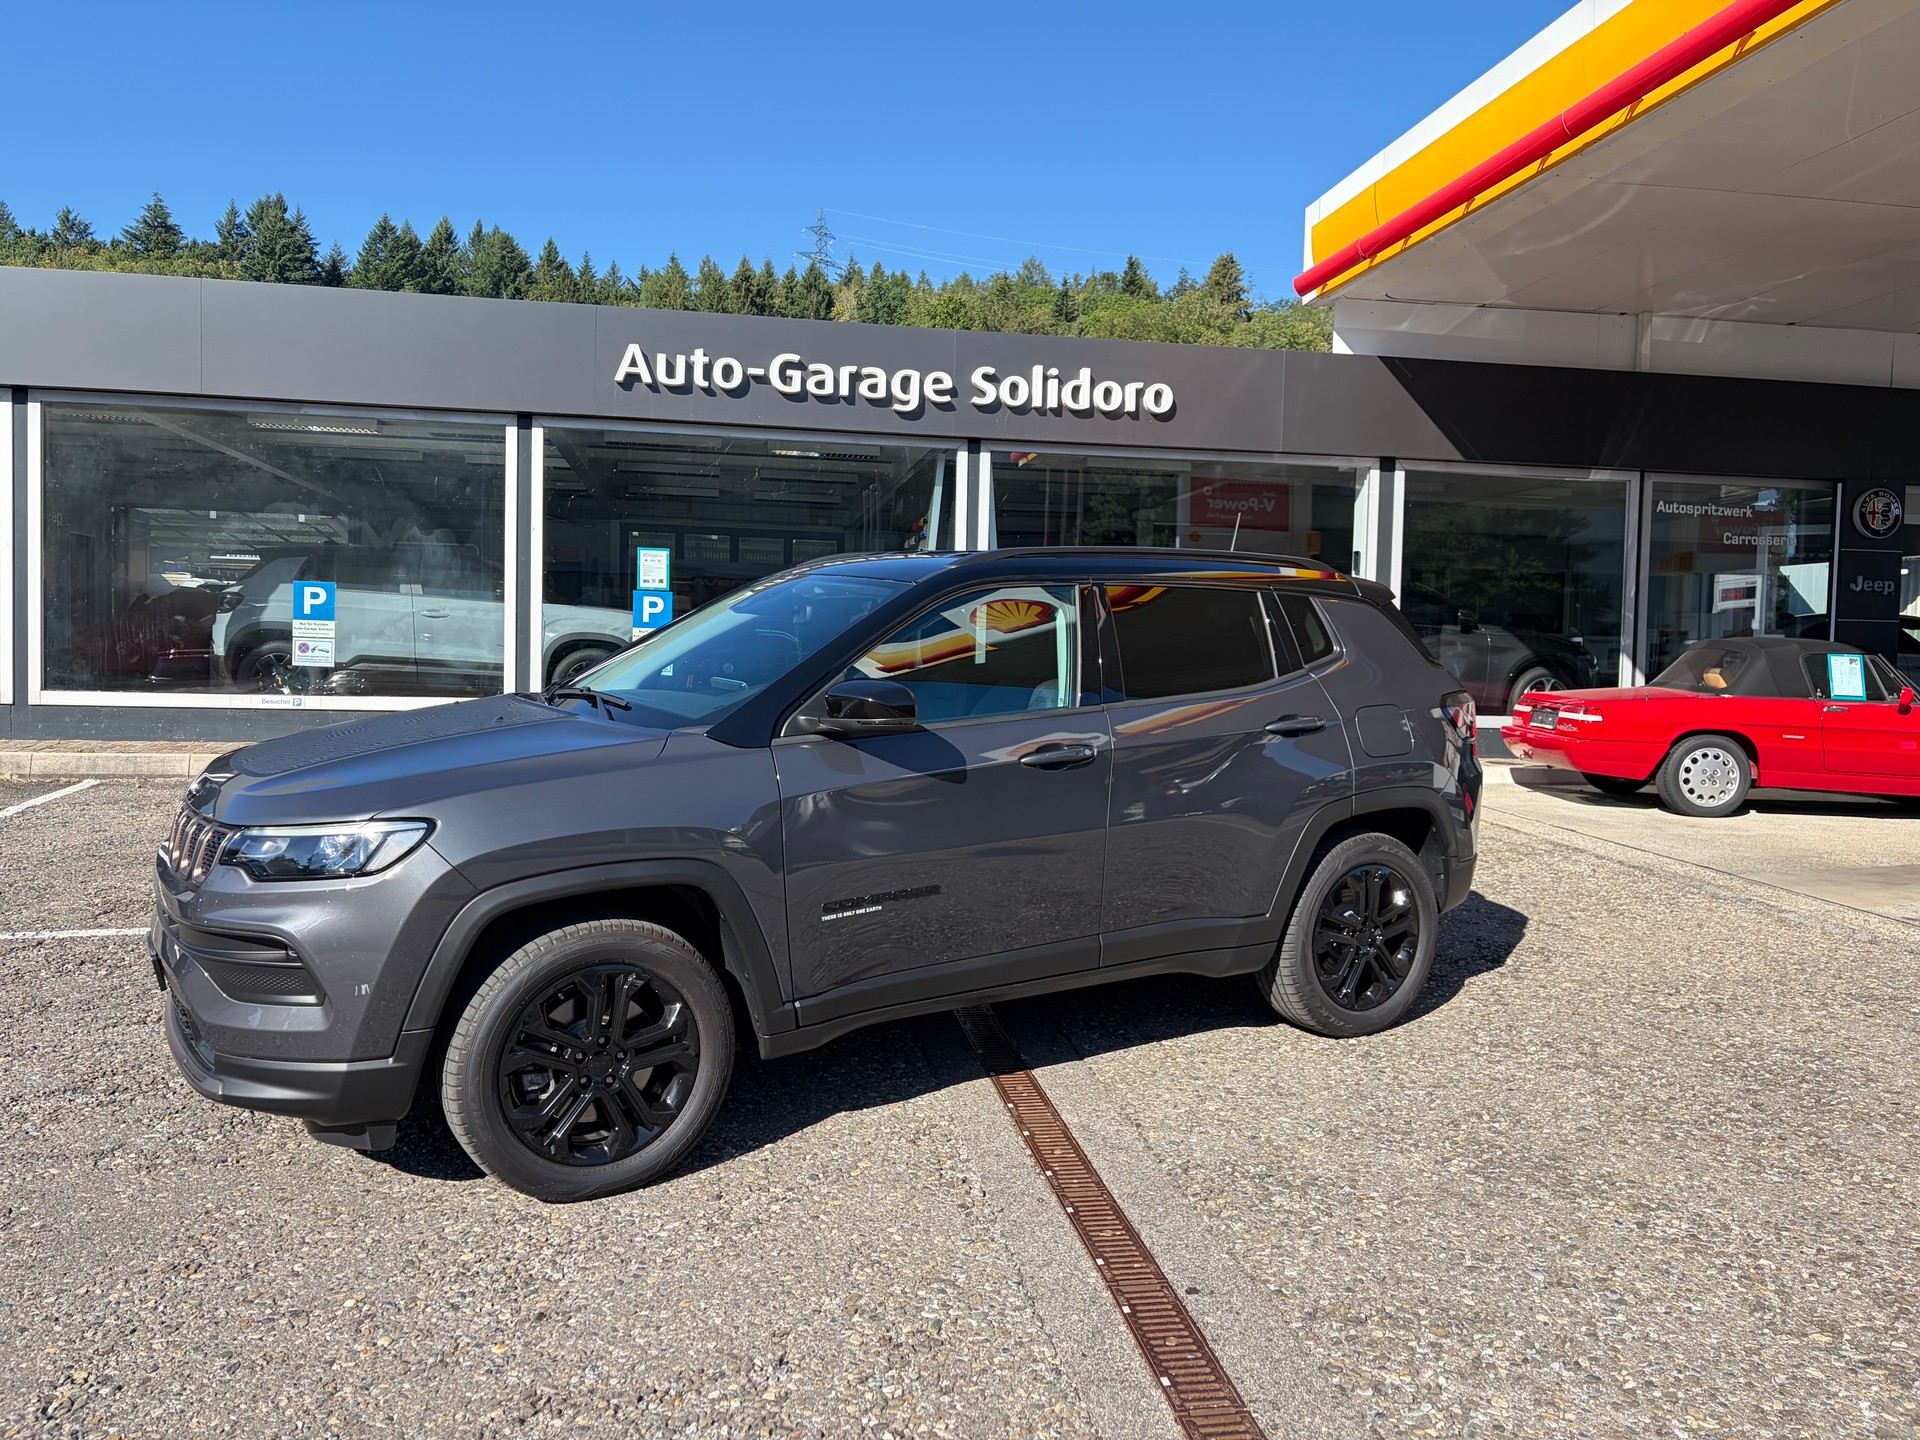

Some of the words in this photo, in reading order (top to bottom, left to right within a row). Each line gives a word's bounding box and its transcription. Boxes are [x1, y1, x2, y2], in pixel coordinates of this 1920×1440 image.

[614, 343, 952, 413] Auto-Garage
[971, 364, 1175, 415] Solidoro
[1656, 500, 1753, 518] Autospritzwerk
[1861, 493, 1876, 513] ALFA
[1878, 491, 1900, 515] ROMEO
[1723, 532, 1797, 546] Carrosserie
[1849, 575, 1895, 595] Jeep
[303, 586, 327, 615] P
[643, 596, 664, 623] P
[821, 914, 837, 922] THERE
[866, 905, 883, 913] EARTH
